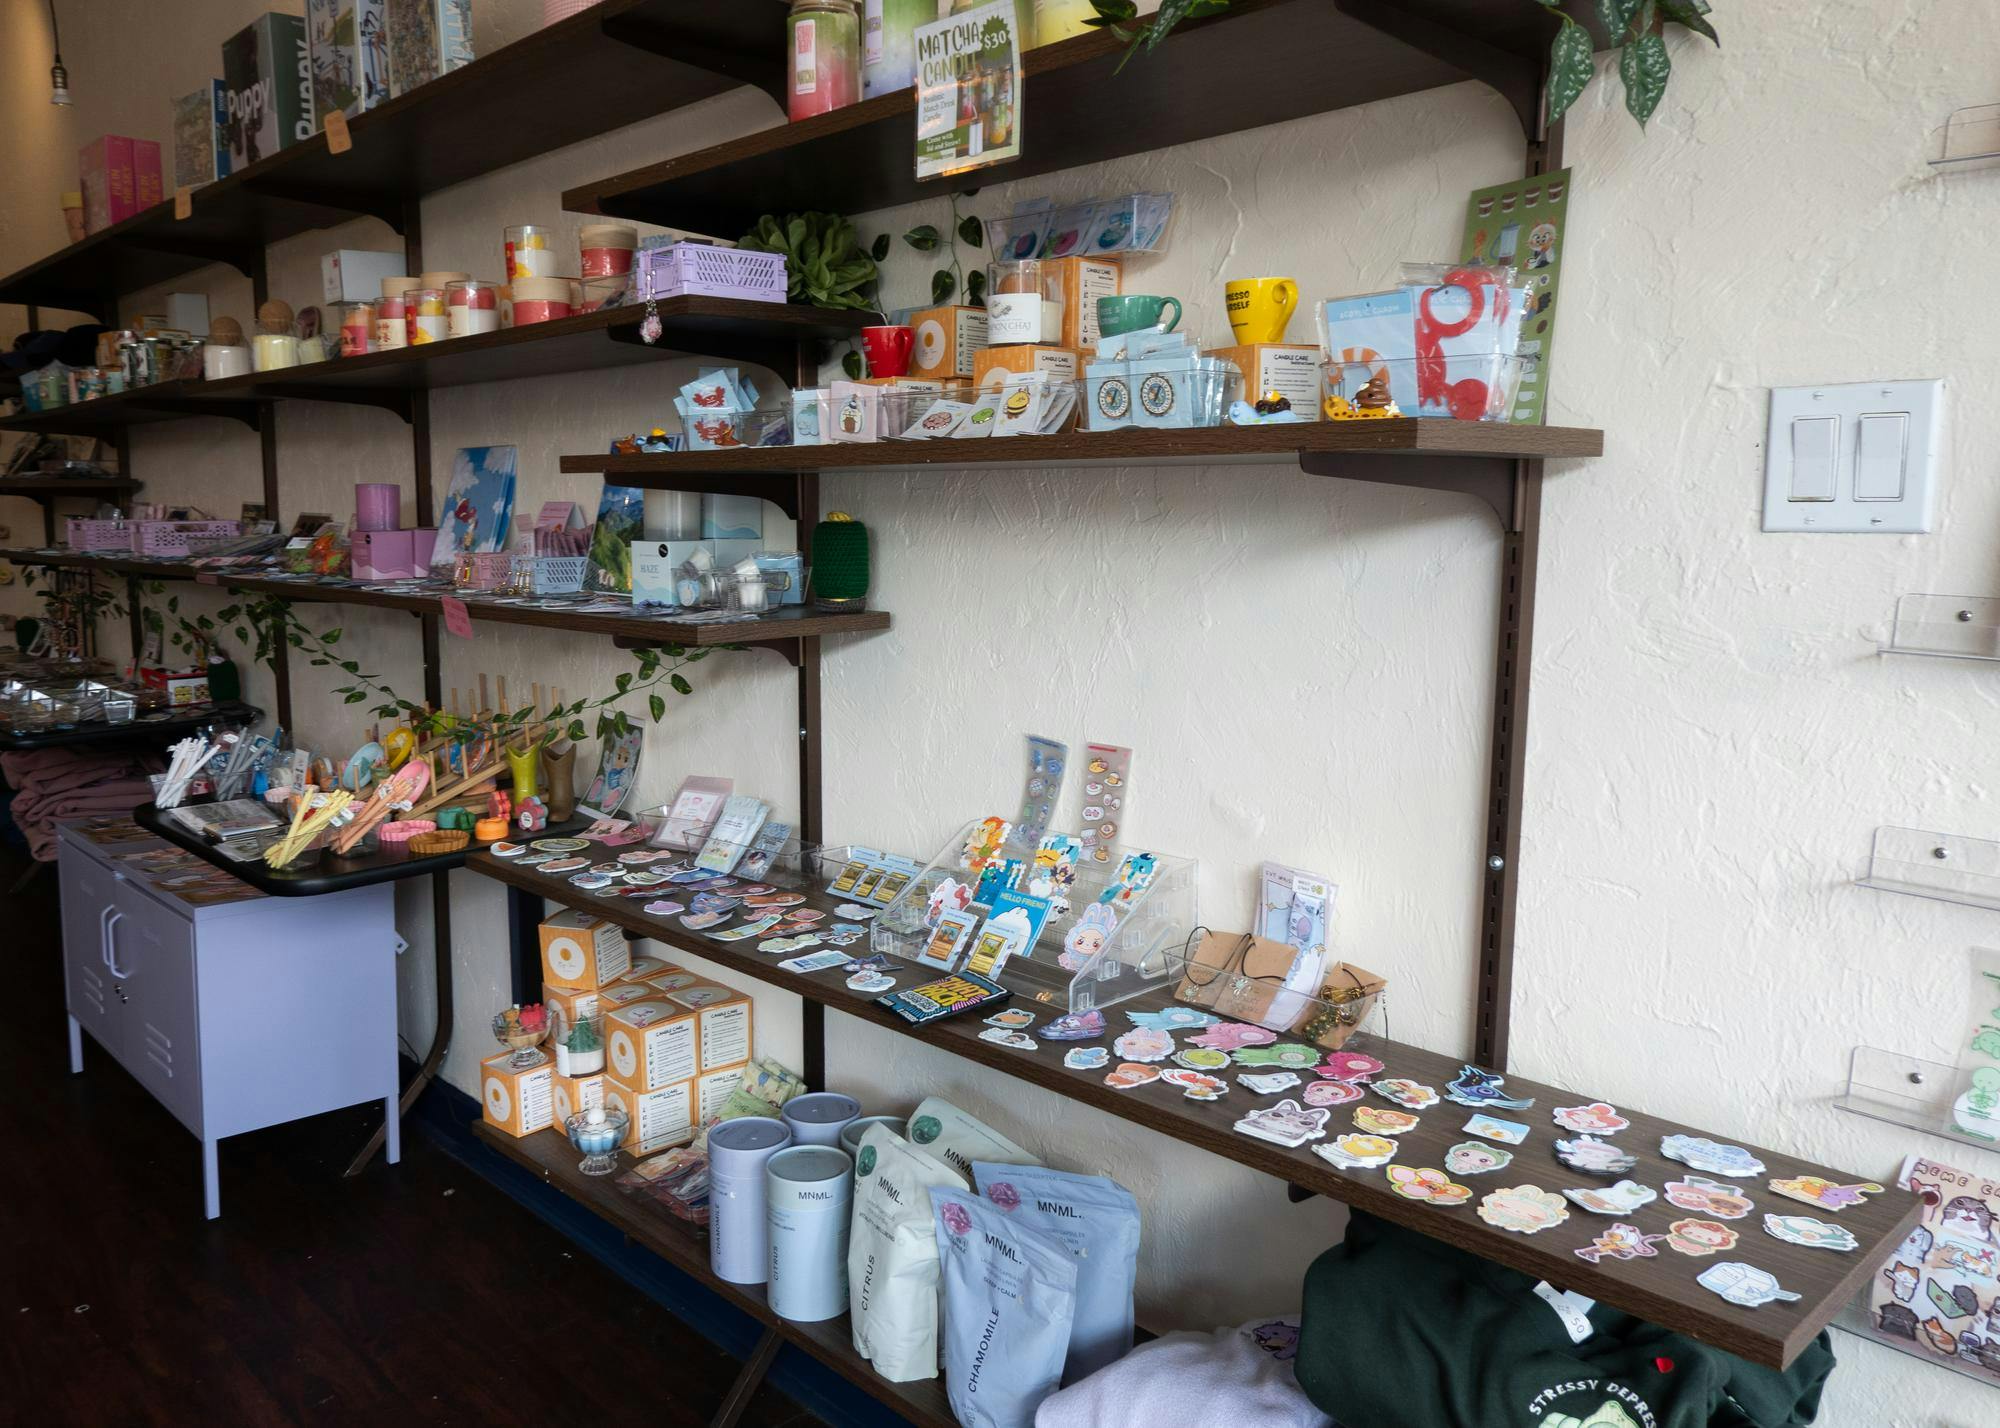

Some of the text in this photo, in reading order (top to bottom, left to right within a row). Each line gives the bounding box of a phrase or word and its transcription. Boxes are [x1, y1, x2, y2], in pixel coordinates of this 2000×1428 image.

[918, 21, 980, 61] MATCHA
[984, 30, 1006, 50] $30
[227, 77, 271, 122] Puppy
[1000, 891, 1046, 909] HELLO FRIEND
[912, 984, 969, 1007] PACK
[939, 976, 991, 999] THAT
[656, 1029, 672, 1037] CANDLE
[1914, 1161, 1968, 1187] MEME
[862, 1254, 876, 1311] CITRUS
[1001, 1289, 1017, 1299] CALM
[968, 1306, 1000, 1393] CHAMOMILE
[1528, 1379, 1599, 1416] STRESSY
